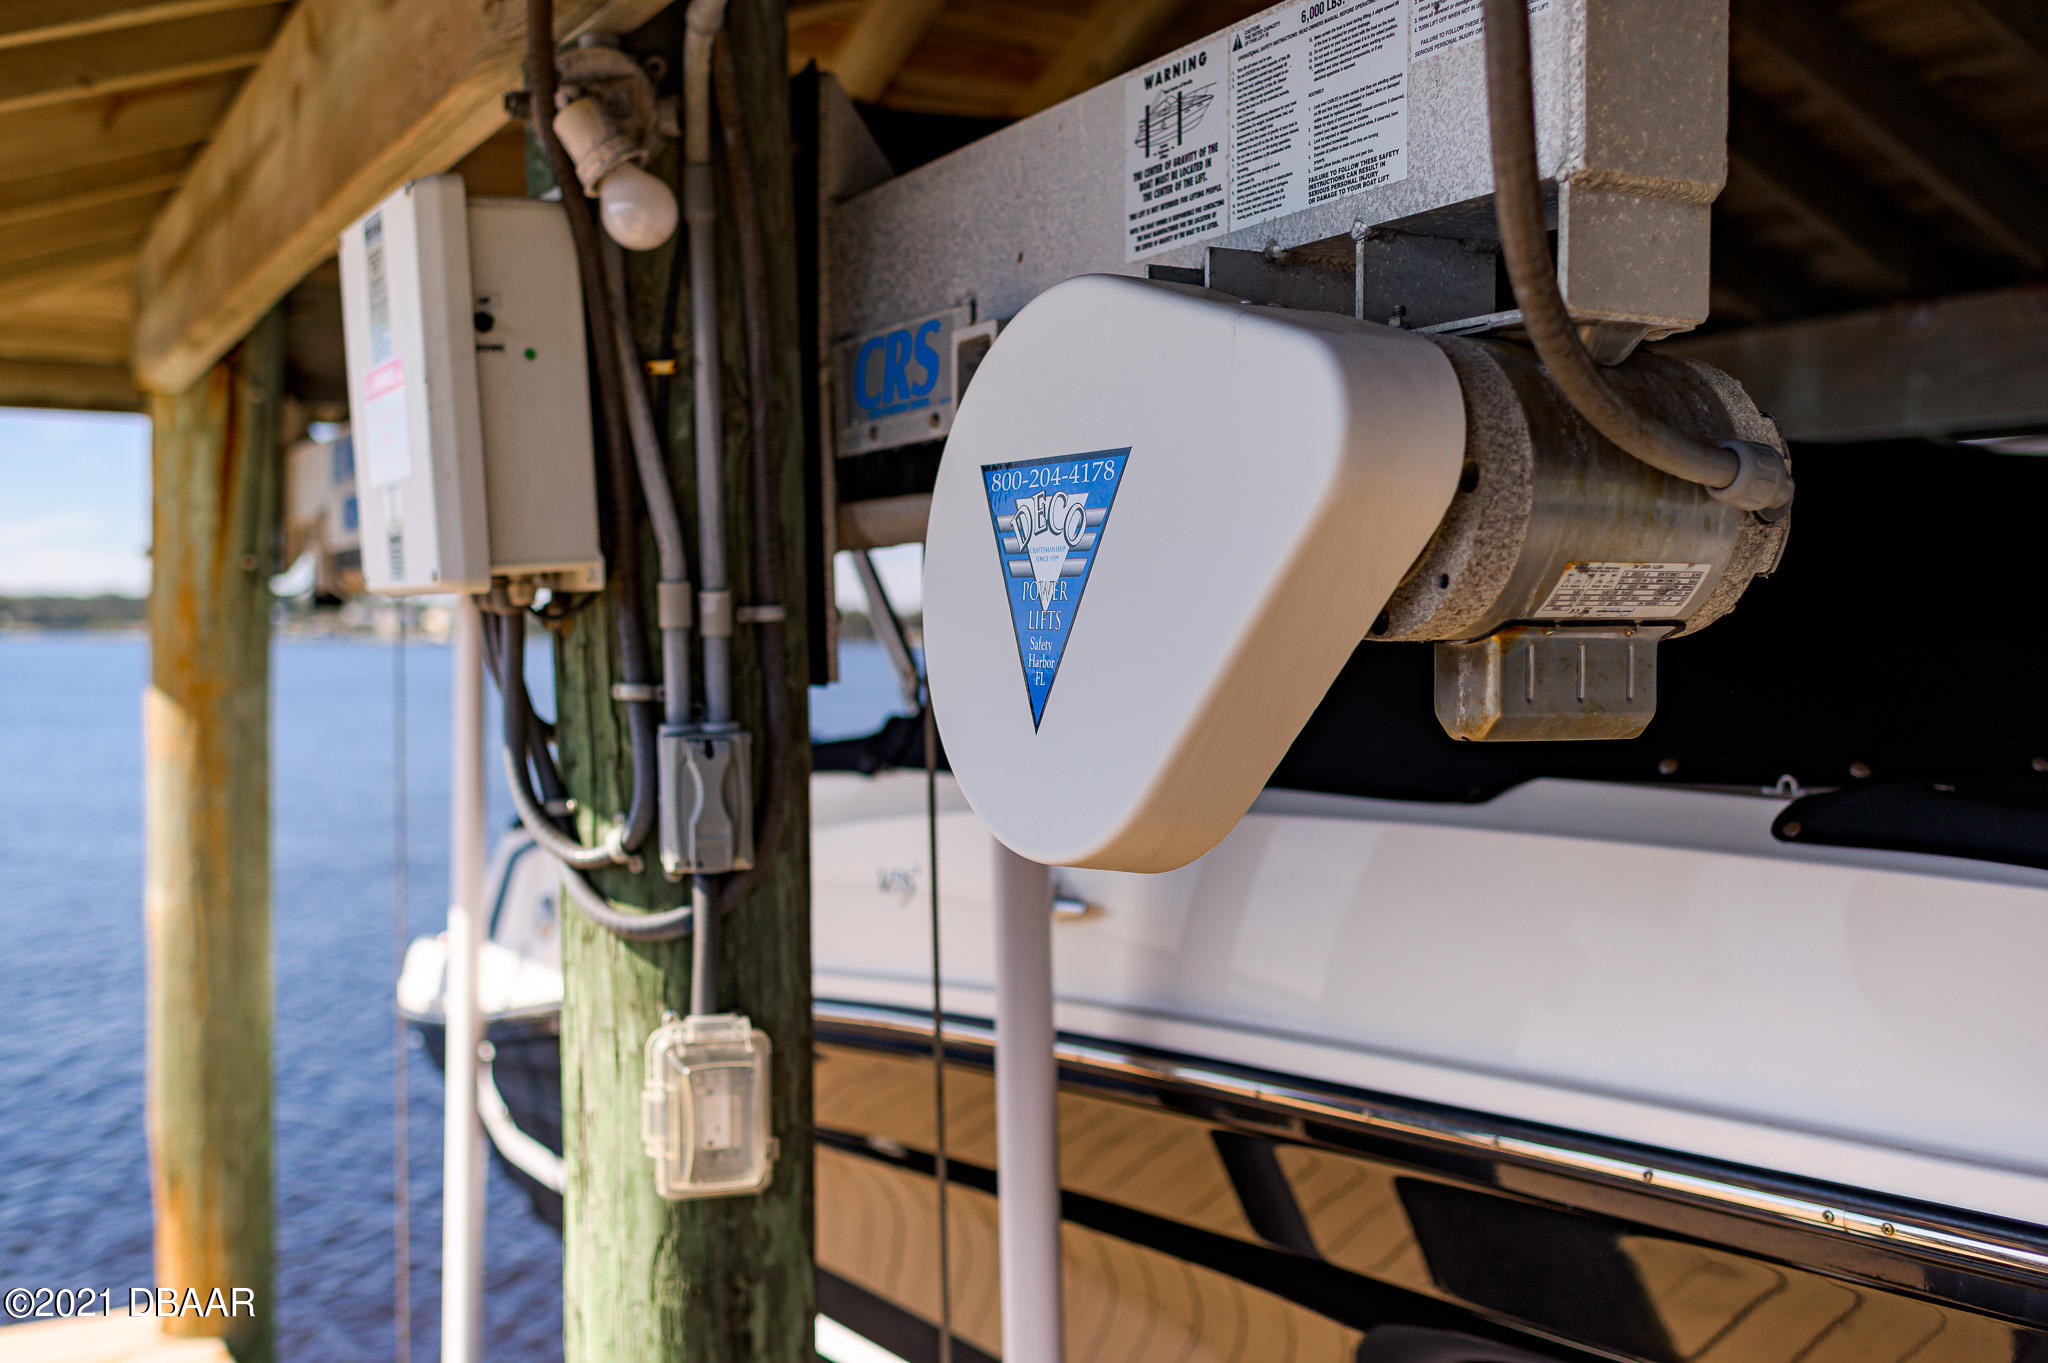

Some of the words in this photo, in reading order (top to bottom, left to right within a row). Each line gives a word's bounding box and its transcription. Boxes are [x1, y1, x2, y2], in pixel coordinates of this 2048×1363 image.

[1302, 2, 1324, 24] 6,000
[1144, 52, 1208, 90] WARNING
[1308, 171, 1328, 183] FAILURE
[1338, 162, 1358, 174] FOLLOW
[1361, 156, 1377, 167] THESE
[1379, 149, 1399, 161] SAFETY
[1308, 174, 1345, 190] INSTRUCTIONS
[1347, 170, 1357, 178] CAN
[1359, 163, 1378, 175] RESULT
[1308, 186, 1330, 198] SERIOUS
[1331, 177, 1358, 190] PERSONAL
[1359, 170, 1378, 182] INJURY
[1317, 190, 1337, 202] DAMAGE
[1347, 183, 1361, 193] YOUR
[1363, 178, 1376, 188] BOAT
[1378, 174, 1389, 184] LIFT
[854, 319, 941, 410] CRS
[992, 460, 1115, 491] 800-204-4178
[1011, 490, 1087, 552] DECO
[1022, 580, 1068, 602] POWER
[1028, 610, 1062, 631] LIFTS
[1030, 636, 1053, 654] Safety
[1028, 654, 1055, 670] Harbor
[1035, 672, 1045, 686] FL
